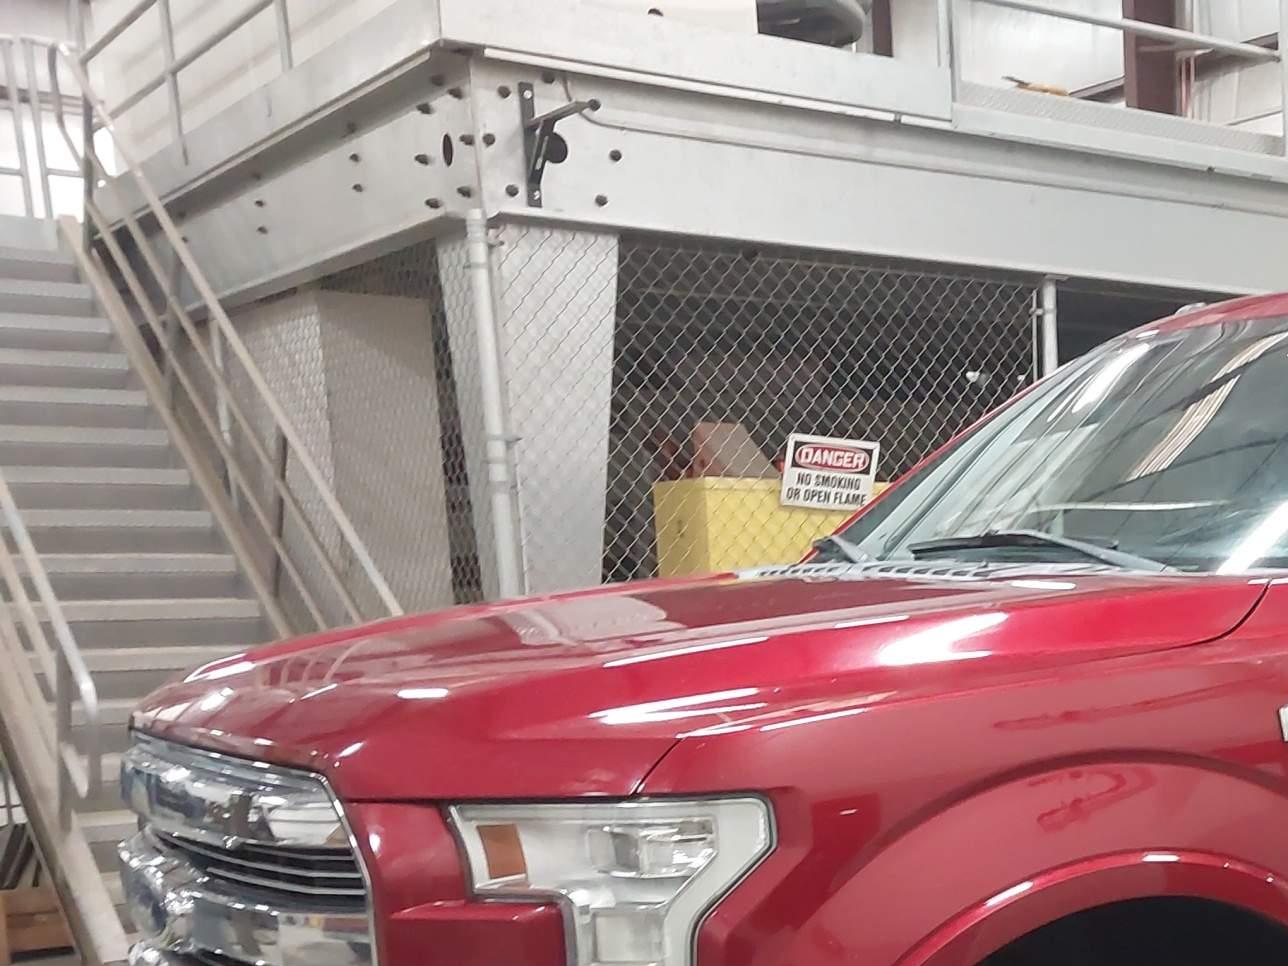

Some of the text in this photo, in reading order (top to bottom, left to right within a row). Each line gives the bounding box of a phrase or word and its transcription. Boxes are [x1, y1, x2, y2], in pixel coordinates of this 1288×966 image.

[799, 447, 865, 469] DANGER
[796, 472, 862, 491] NO SMOKING
[786, 487, 867, 506] OR OPEN FLAME
